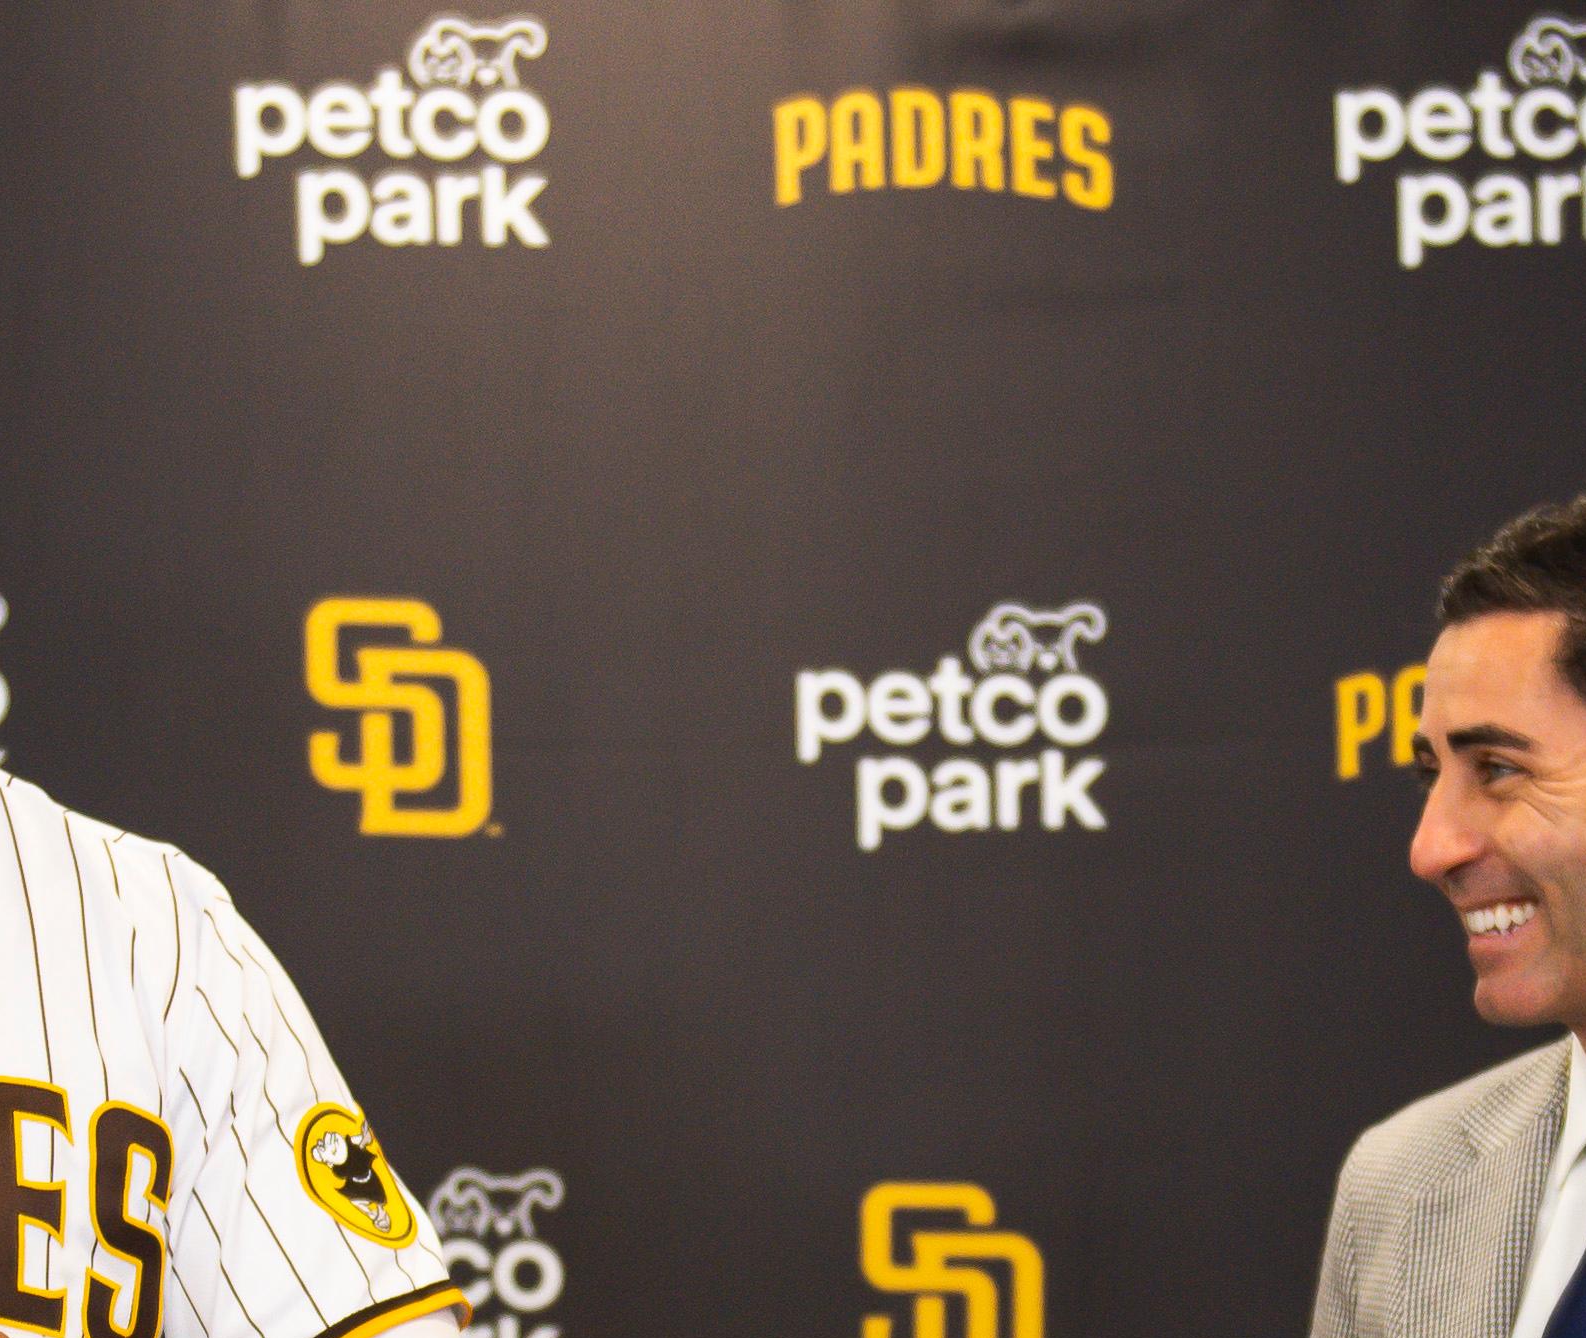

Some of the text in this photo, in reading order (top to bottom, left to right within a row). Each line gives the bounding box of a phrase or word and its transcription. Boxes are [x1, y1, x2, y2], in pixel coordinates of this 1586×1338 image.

[235, 70, 549, 178] petco
[771, 87, 1115, 211] PADRES
[296, 167, 549, 266] park
[304, 598, 492, 837] SD
[794, 656, 1108, 764] petco
[856, 751, 1108, 852] park
